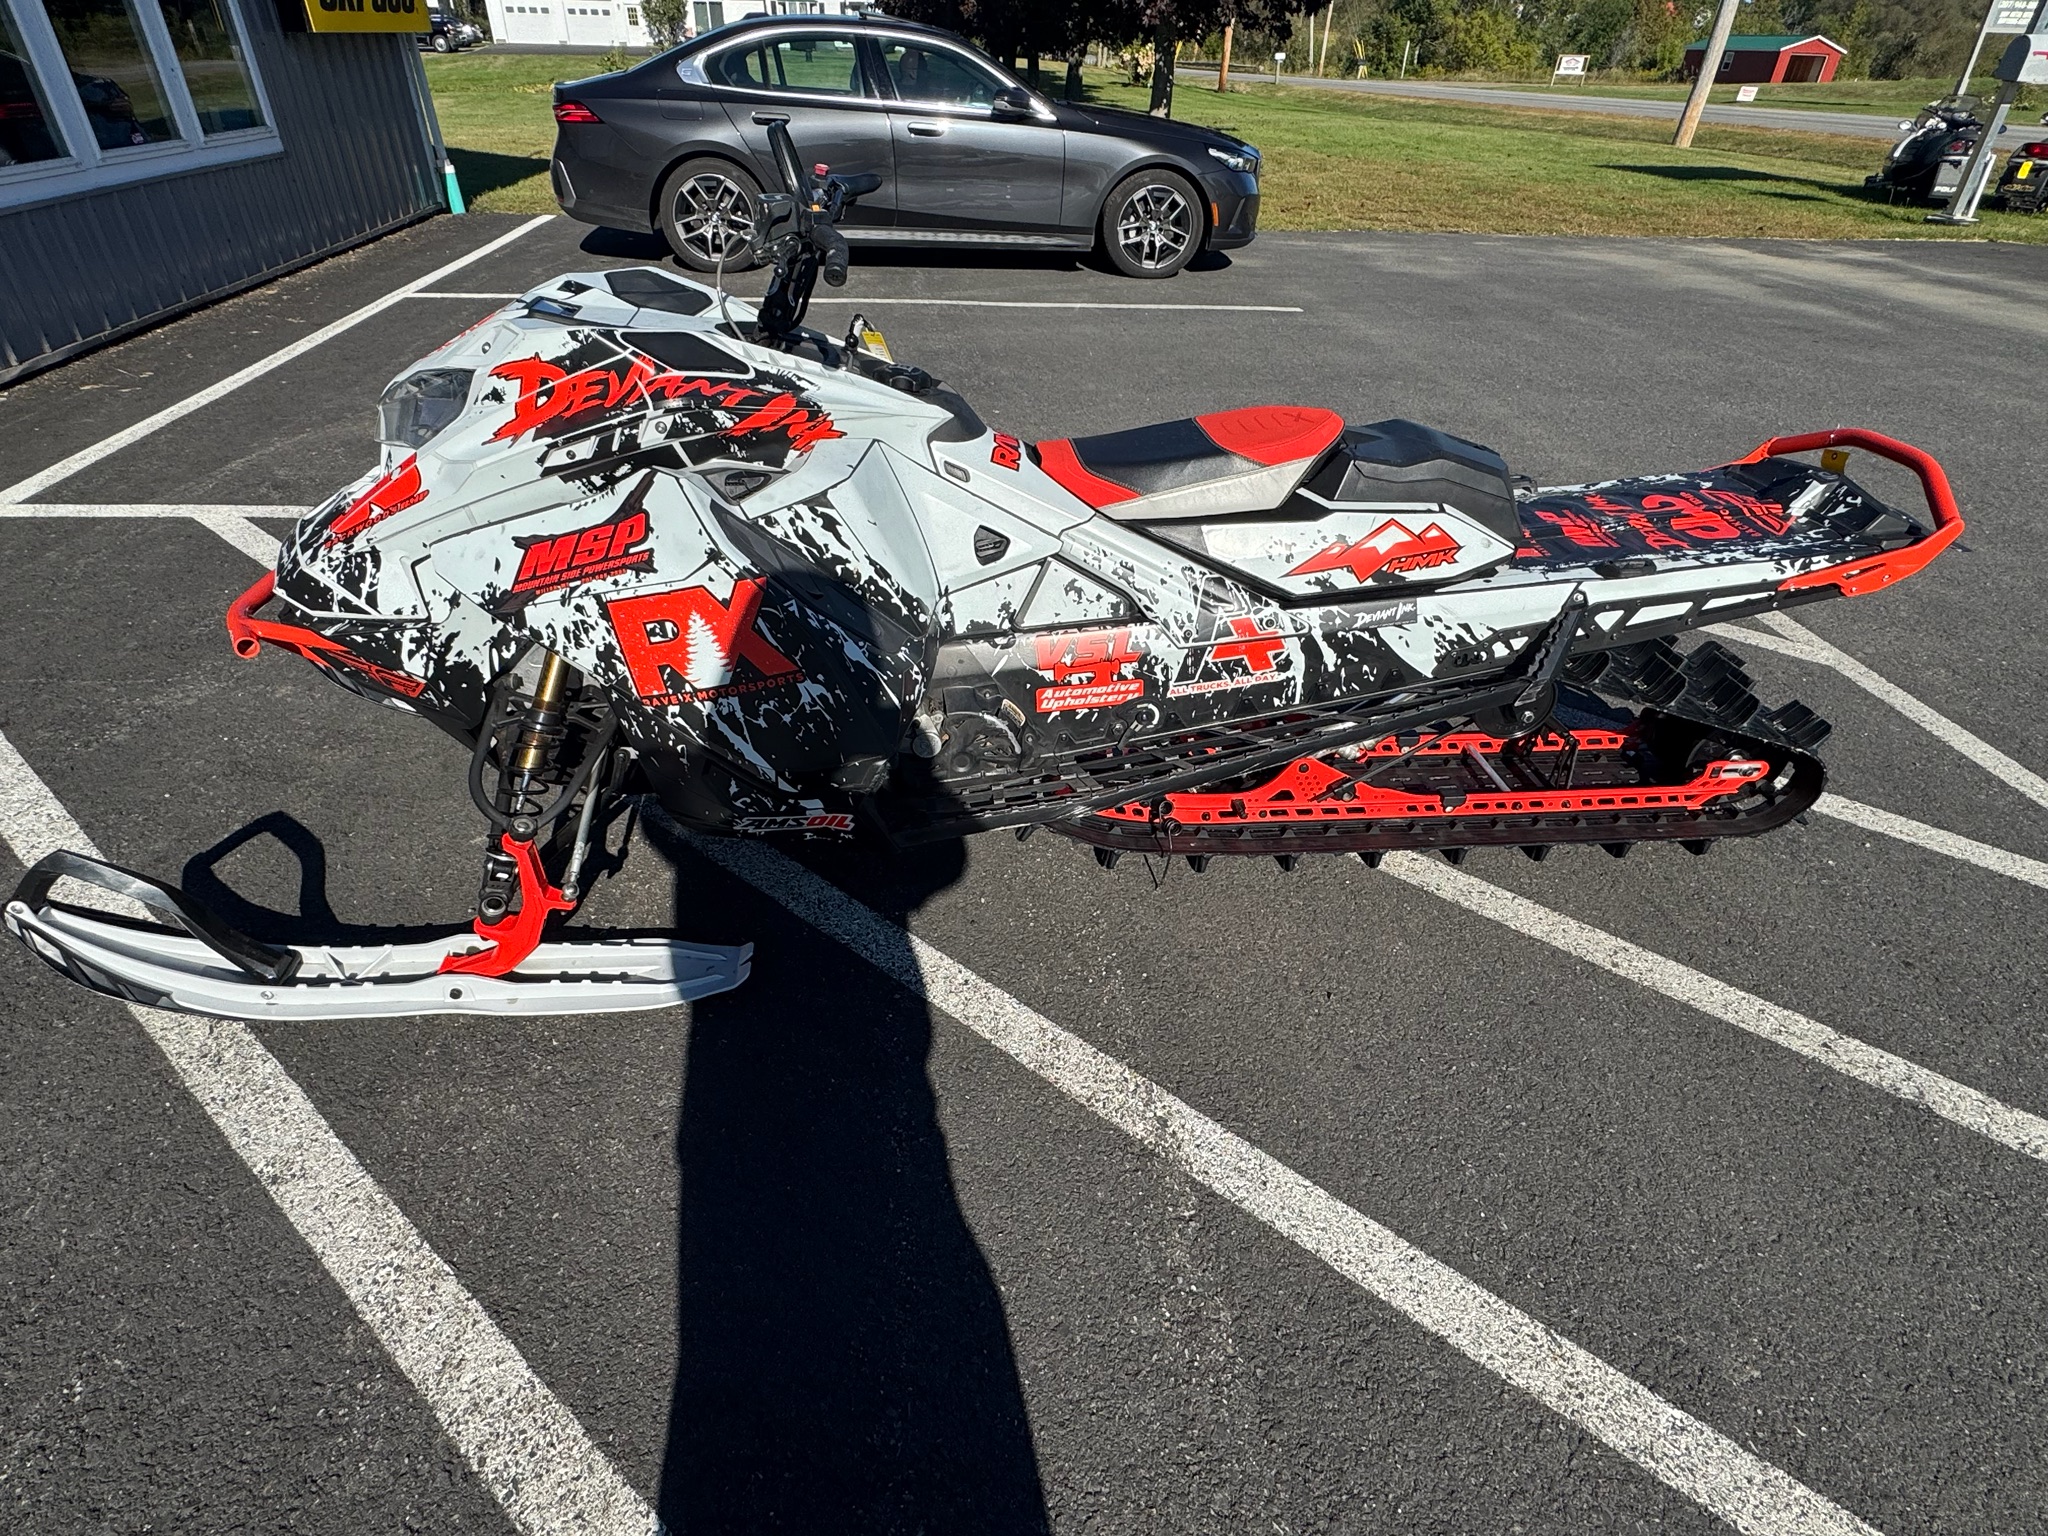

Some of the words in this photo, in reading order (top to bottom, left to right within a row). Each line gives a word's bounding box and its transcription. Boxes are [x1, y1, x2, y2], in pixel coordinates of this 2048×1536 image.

[482, 352, 765, 446] DEVIANT
[716, 392, 848, 451] INK
[517, 512, 646, 581] MSP
[512, 574, 560, 594] MOUNTAIN
[560, 568, 582, 581] SIDE
[582, 551, 650, 576] POWERSPORTS
[1386, 551, 1458, 573] HMK
[1352, 606, 1396, 629] DEVIANT
[1036, 629, 1144, 671] VSL
[698, 672, 805, 701] MOTORSPORTS
[1041, 682, 1140, 699] Automotive
[1169, 687, 1189, 696] ALL
[1234, 677, 1252, 685] ALL
[1255, 673, 1278, 682] DAY.
[1041, 693, 1140, 710] Upholstery
[733, 814, 855, 832] AMSOIL
